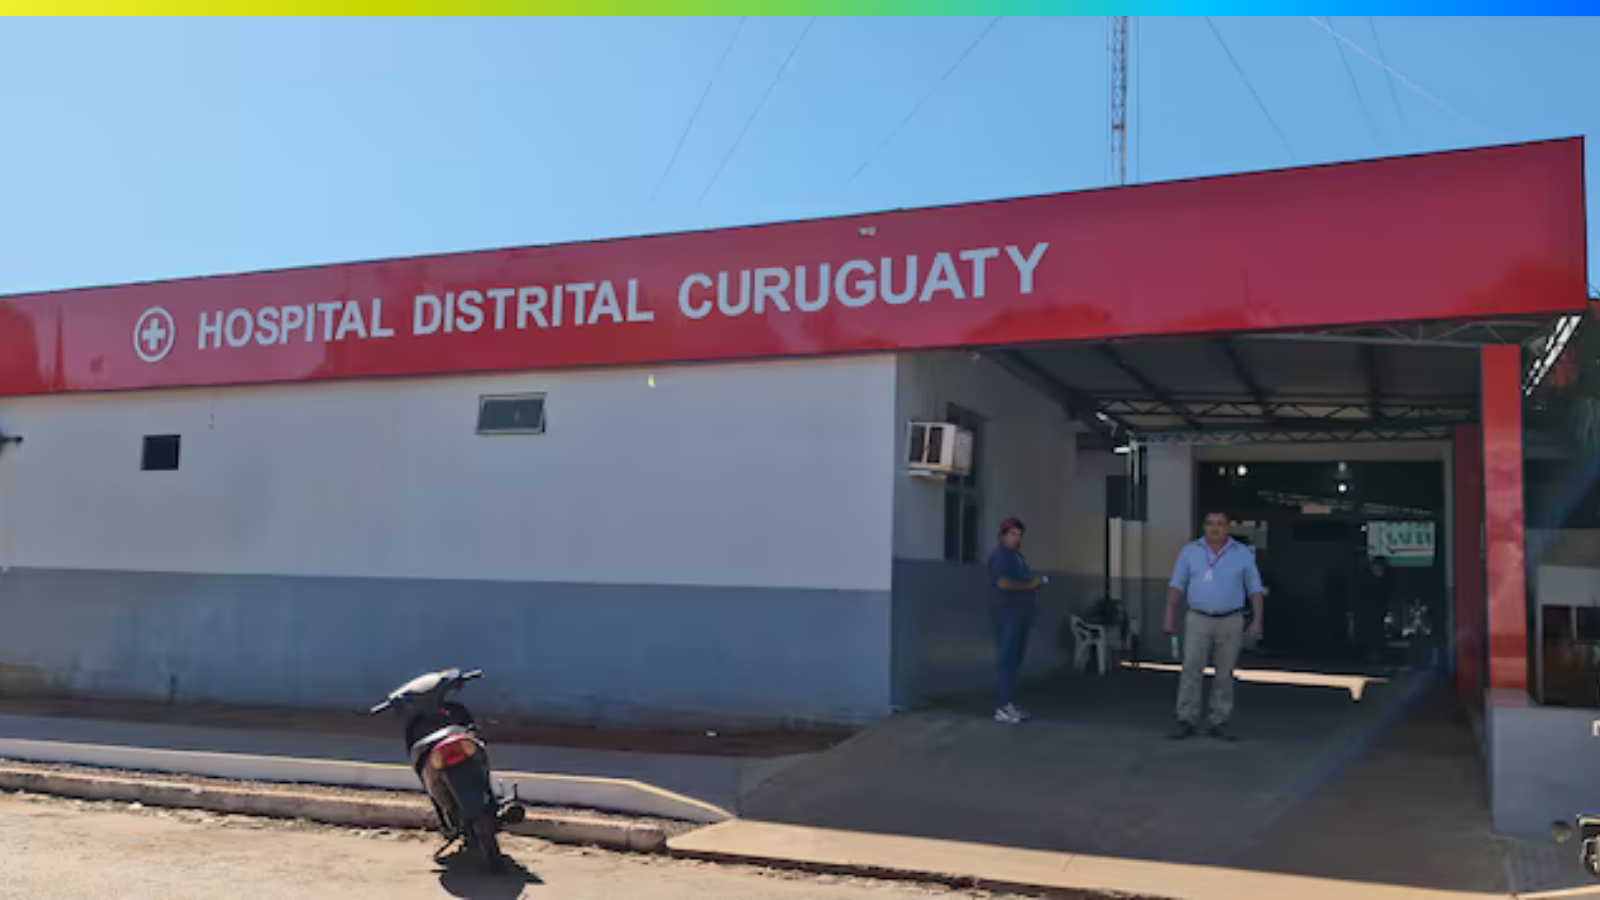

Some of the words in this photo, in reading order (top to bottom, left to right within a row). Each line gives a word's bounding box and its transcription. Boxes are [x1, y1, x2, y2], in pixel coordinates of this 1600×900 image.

[197, 297, 394, 350] HOSPITAL
[413, 278, 654, 336] DISTRITAL
[678, 242, 1049, 319] CURUGUATY
